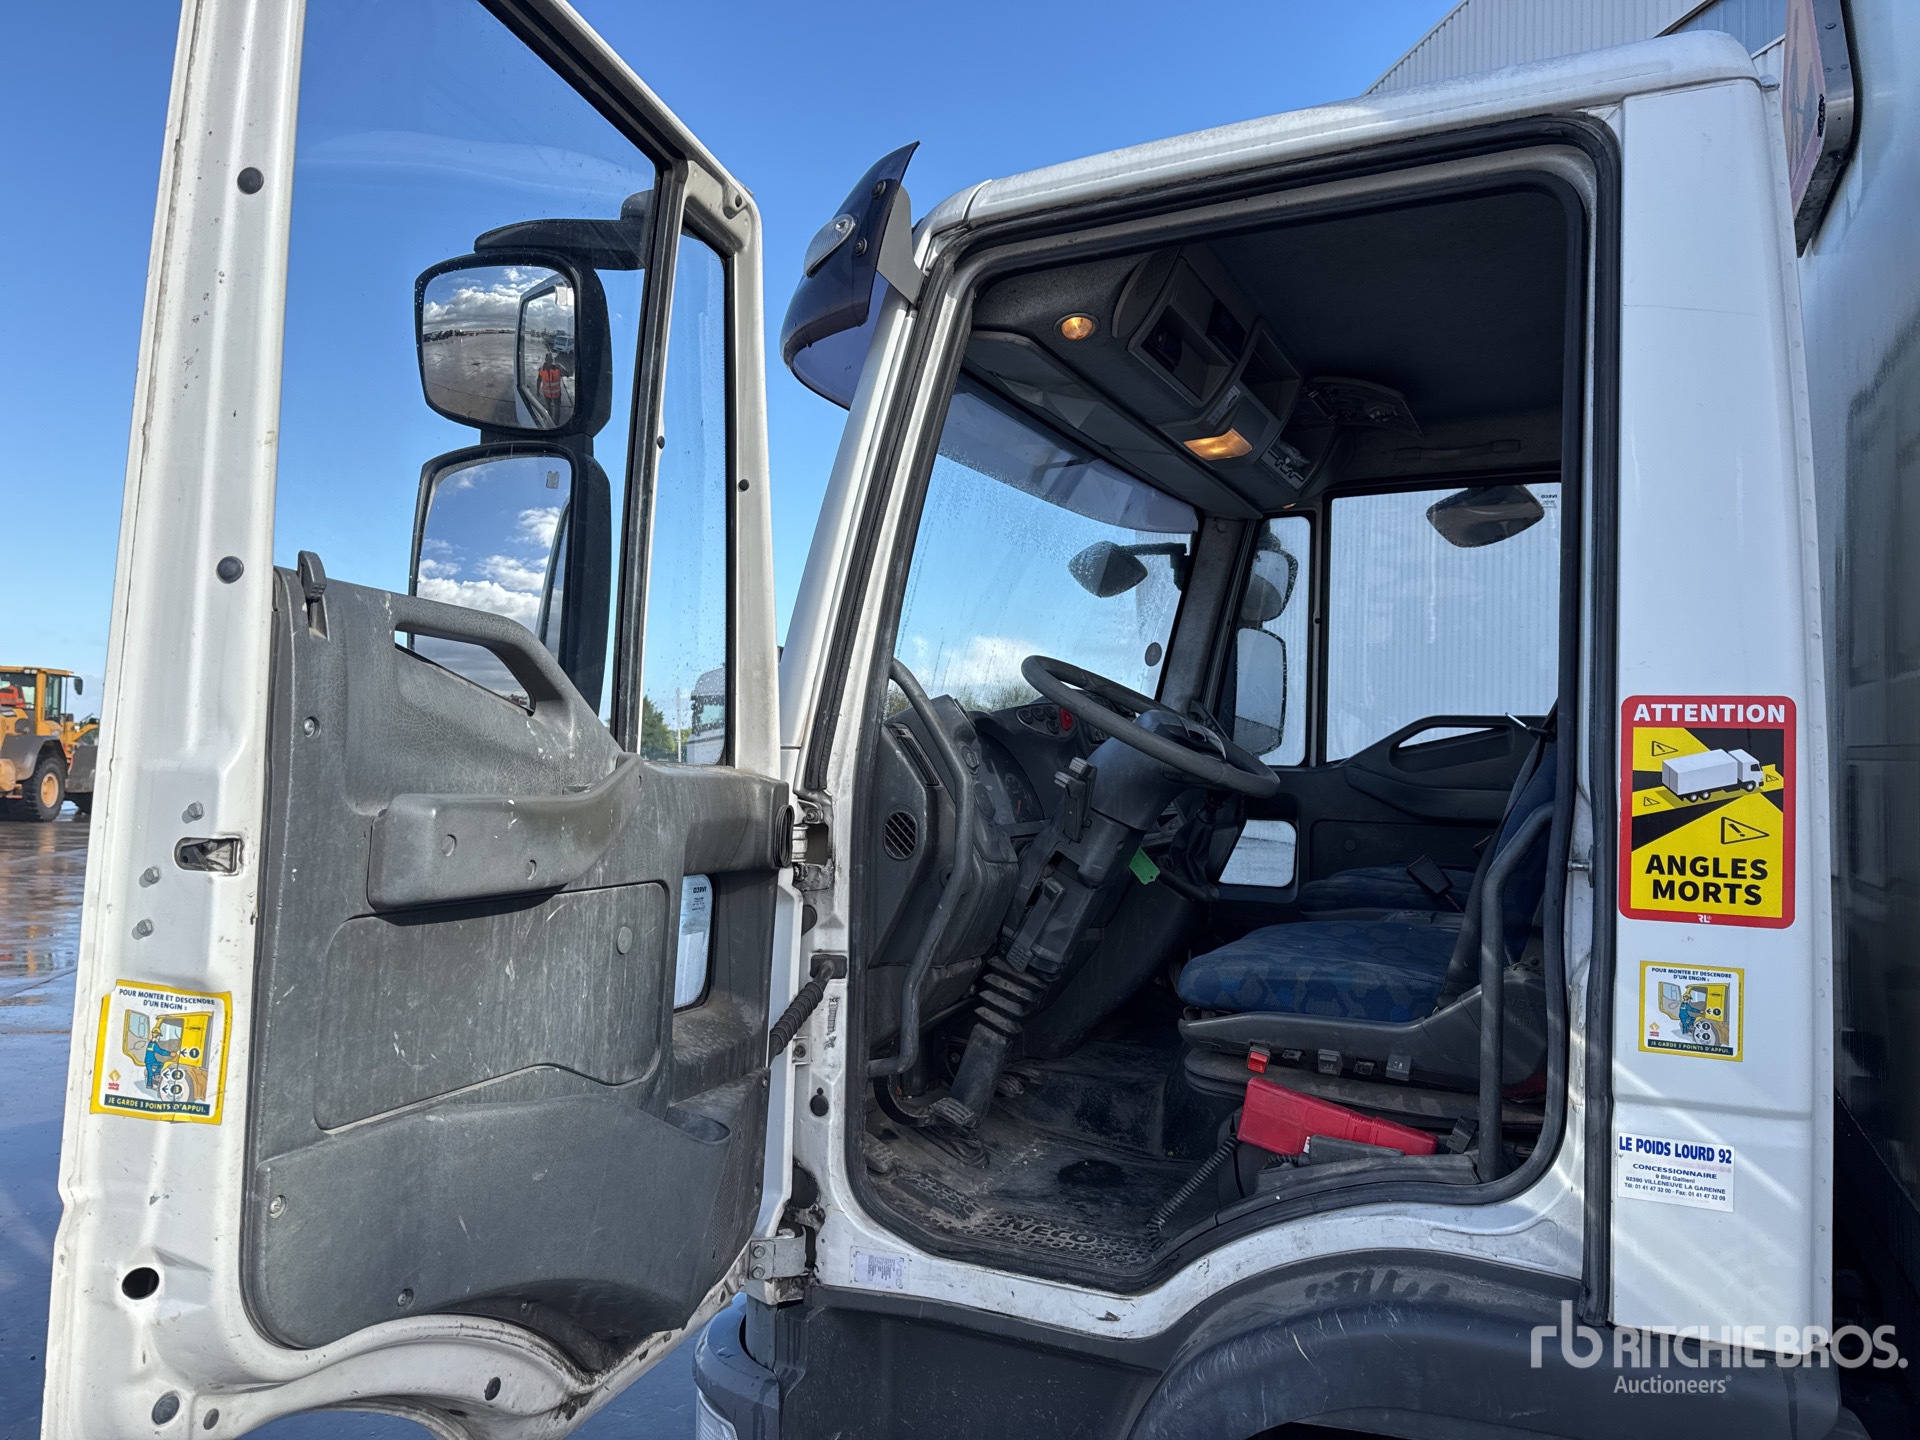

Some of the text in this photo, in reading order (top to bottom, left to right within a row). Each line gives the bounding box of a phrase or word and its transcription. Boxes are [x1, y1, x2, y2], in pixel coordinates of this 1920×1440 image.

[1634, 703, 1785, 723] ATTENTION
[1645, 854, 1768, 880] ANGLES
[1652, 880, 1762, 905] MORTS
[119, 989, 136, 997] POUR
[138, 991, 164, 1000] MONTER
[176, 996, 215, 1005] DESCENDRE
[143, 999, 159, 1007] D'UN
[160, 1002, 183, 1010] ENGIN
[117, 1099, 138, 1107] GARDE
[146, 1102, 171, 1110] POINTS
[1619, 1136, 1732, 1164] LE POIDS LOURD 92
[1632, 1164, 1718, 1179] CONCESSIONNAIRE
[1644, 1179, 1683, 1188] VILLENEUVE
[1694, 1185, 1726, 1194] GARENNE
[895, 1259, 903, 1289] VDO
